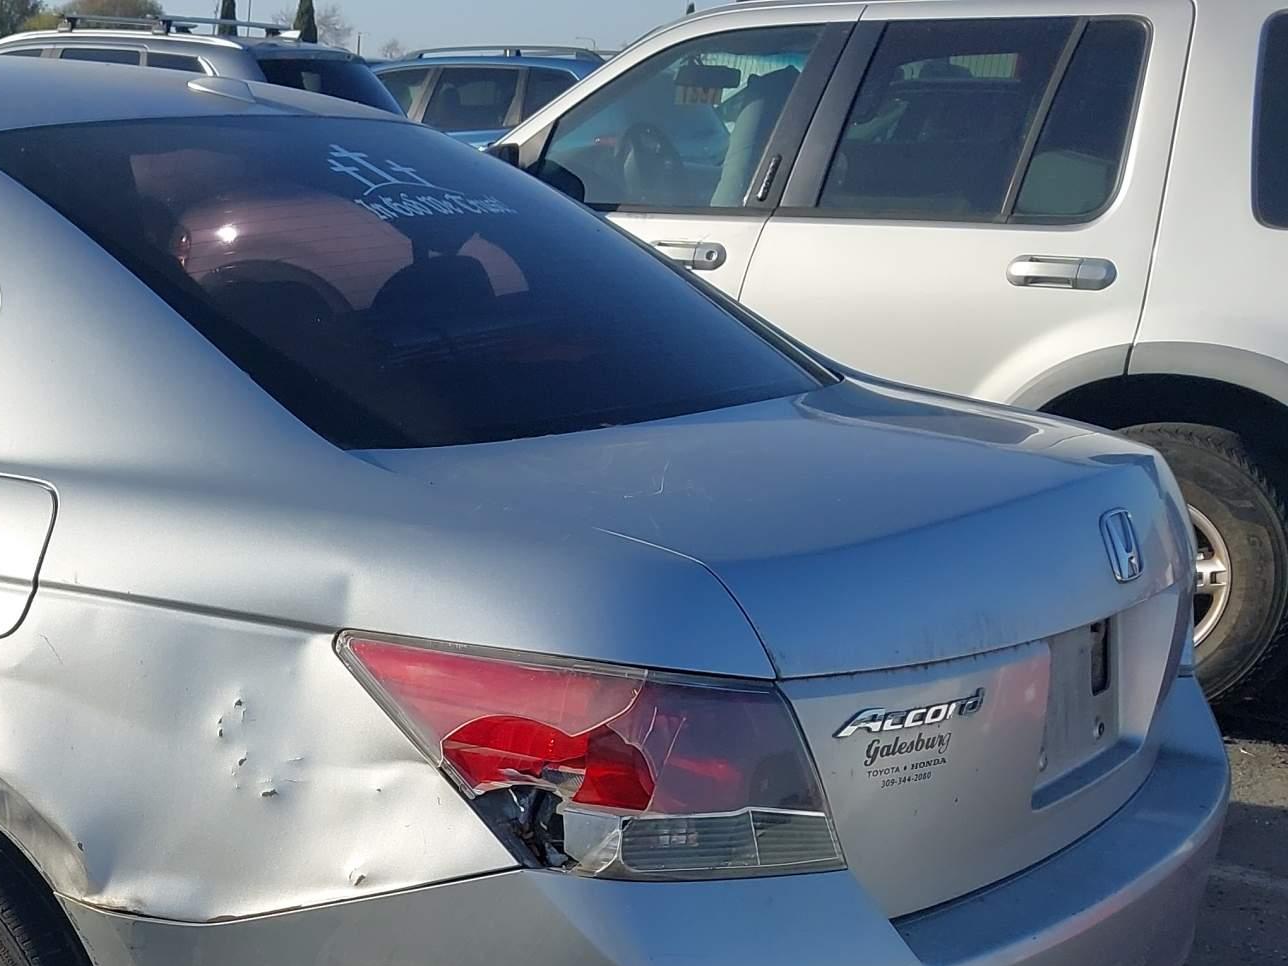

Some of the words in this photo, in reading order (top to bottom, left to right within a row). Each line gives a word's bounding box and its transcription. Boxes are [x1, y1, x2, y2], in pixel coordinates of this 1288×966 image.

[831, 687, 986, 738] Accord
[864, 731, 952, 767] Galesburg
[867, 765, 900, 779] TOYOTA
[910, 756, 947, 771] HONDA
